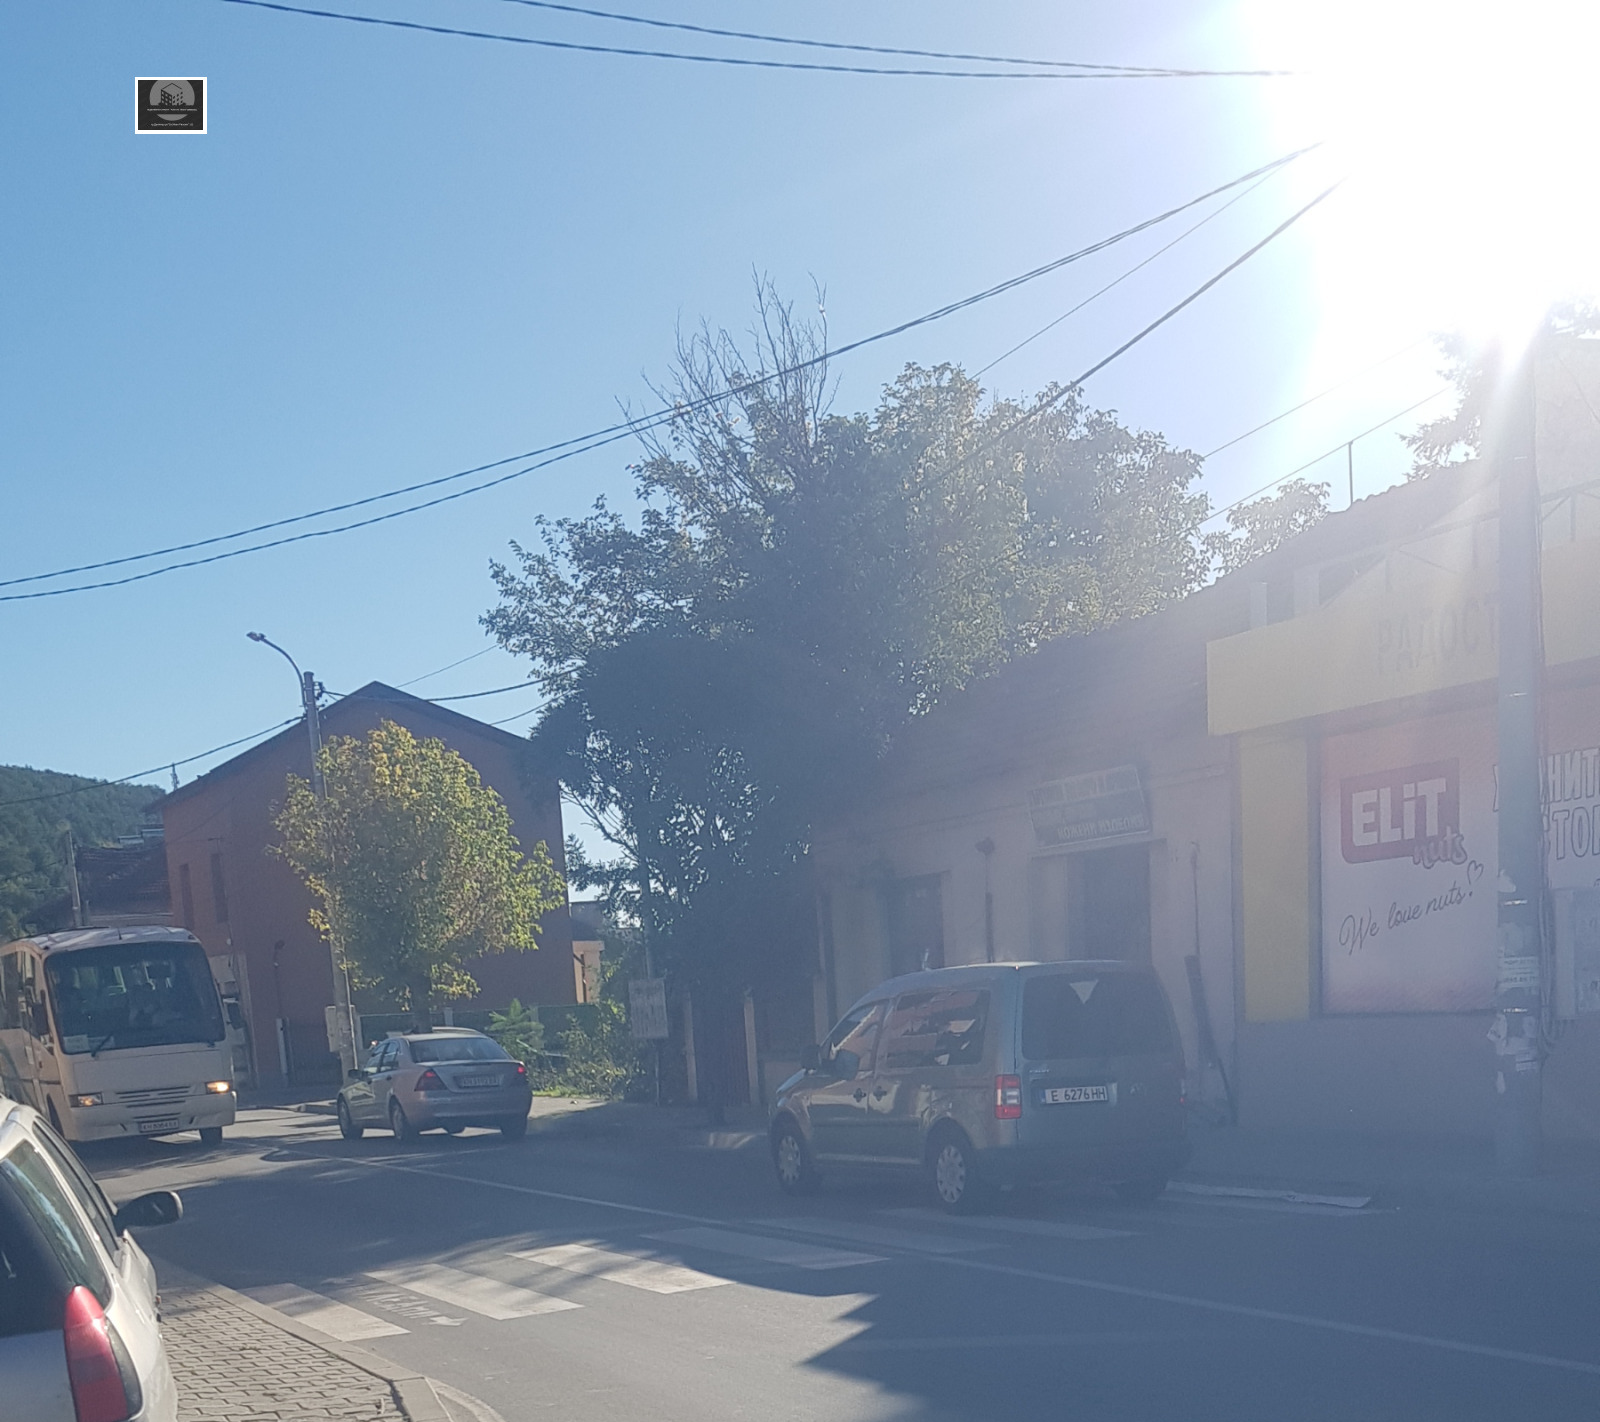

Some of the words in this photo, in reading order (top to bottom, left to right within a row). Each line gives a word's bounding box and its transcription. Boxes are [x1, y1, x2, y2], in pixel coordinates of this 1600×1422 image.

[1413, 825, 1468, 870] nuts
[1338, 905, 1380, 956] We
[1387, 902, 1424, 930] love
[1051, 1090, 1058, 1101] E
[1064, 1088, 1090, 1100] 6276
